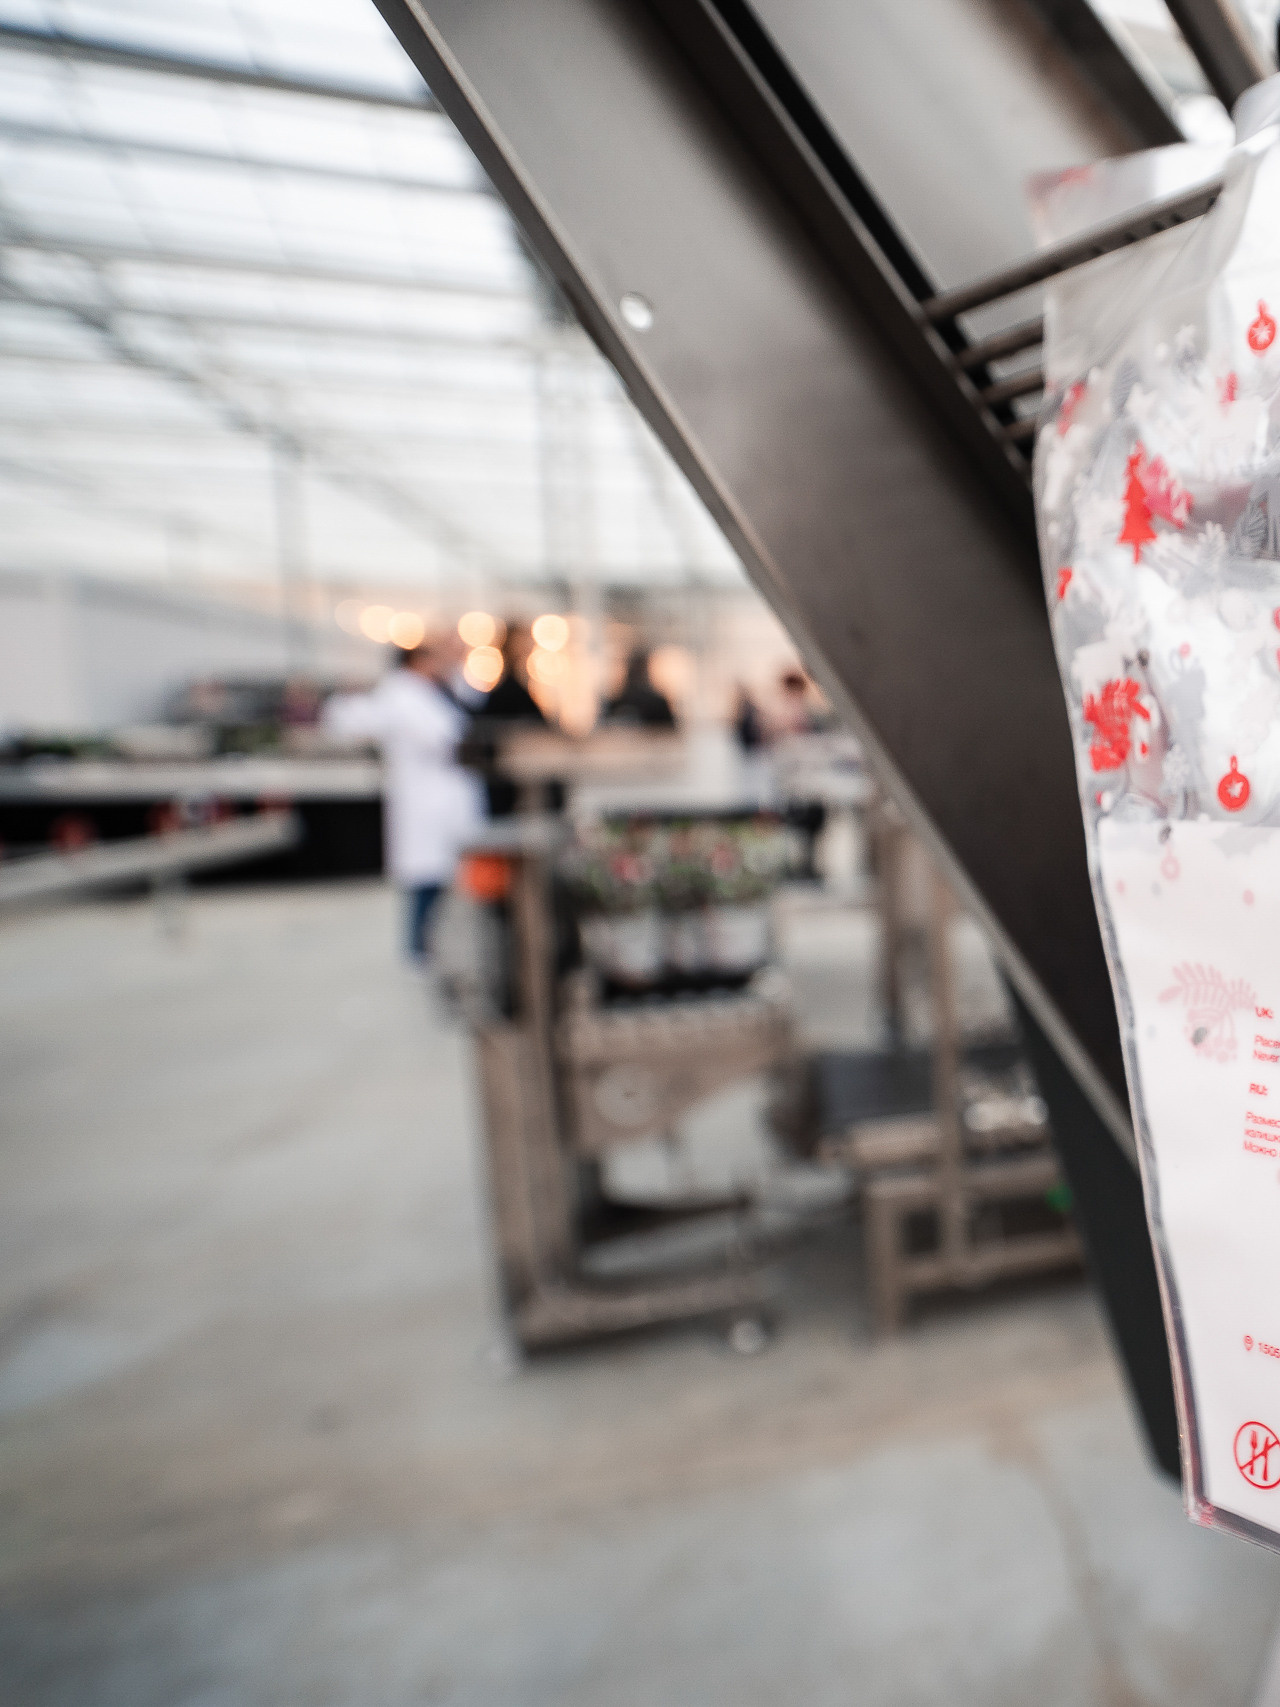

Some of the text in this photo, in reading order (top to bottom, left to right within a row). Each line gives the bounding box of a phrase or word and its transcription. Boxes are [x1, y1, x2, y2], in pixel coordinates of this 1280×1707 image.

[1255, 1006, 1274, 1019] UK:
[1253, 1049, 1279, 1064] Never
[1243, 1140, 1278, 1159] Можно
